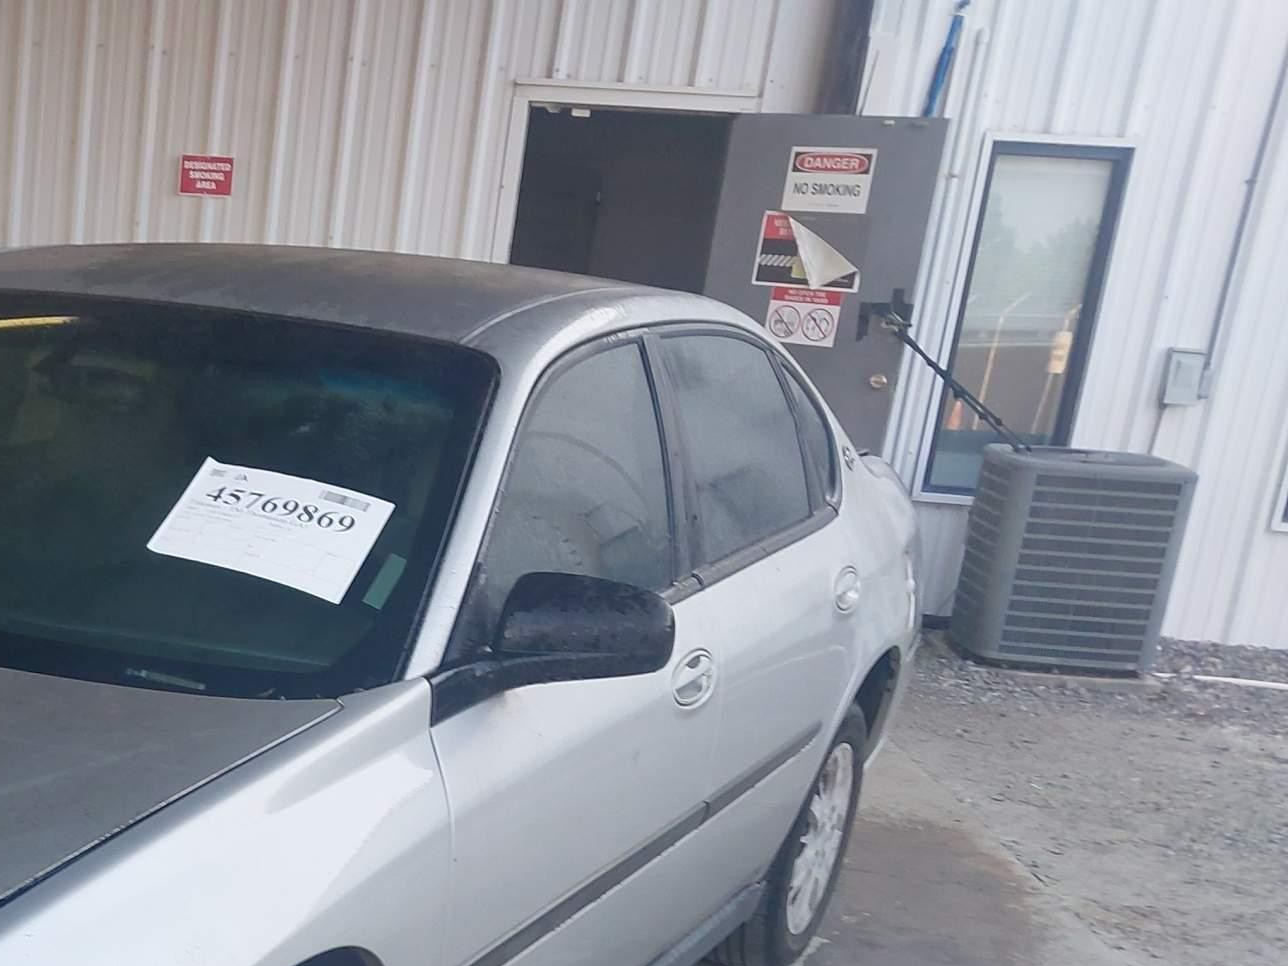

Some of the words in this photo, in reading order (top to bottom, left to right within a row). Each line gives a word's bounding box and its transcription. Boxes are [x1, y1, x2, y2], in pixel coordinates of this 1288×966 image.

[183, 160, 232, 170] DESIGNATED
[803, 157, 860, 169] DANGER
[189, 170, 225, 180] SMOKING
[195, 180, 217, 189] AREA
[793, 182, 809, 195] NO
[811, 183, 861, 197] SMOKING
[205, 486, 356, 532] 45769869
